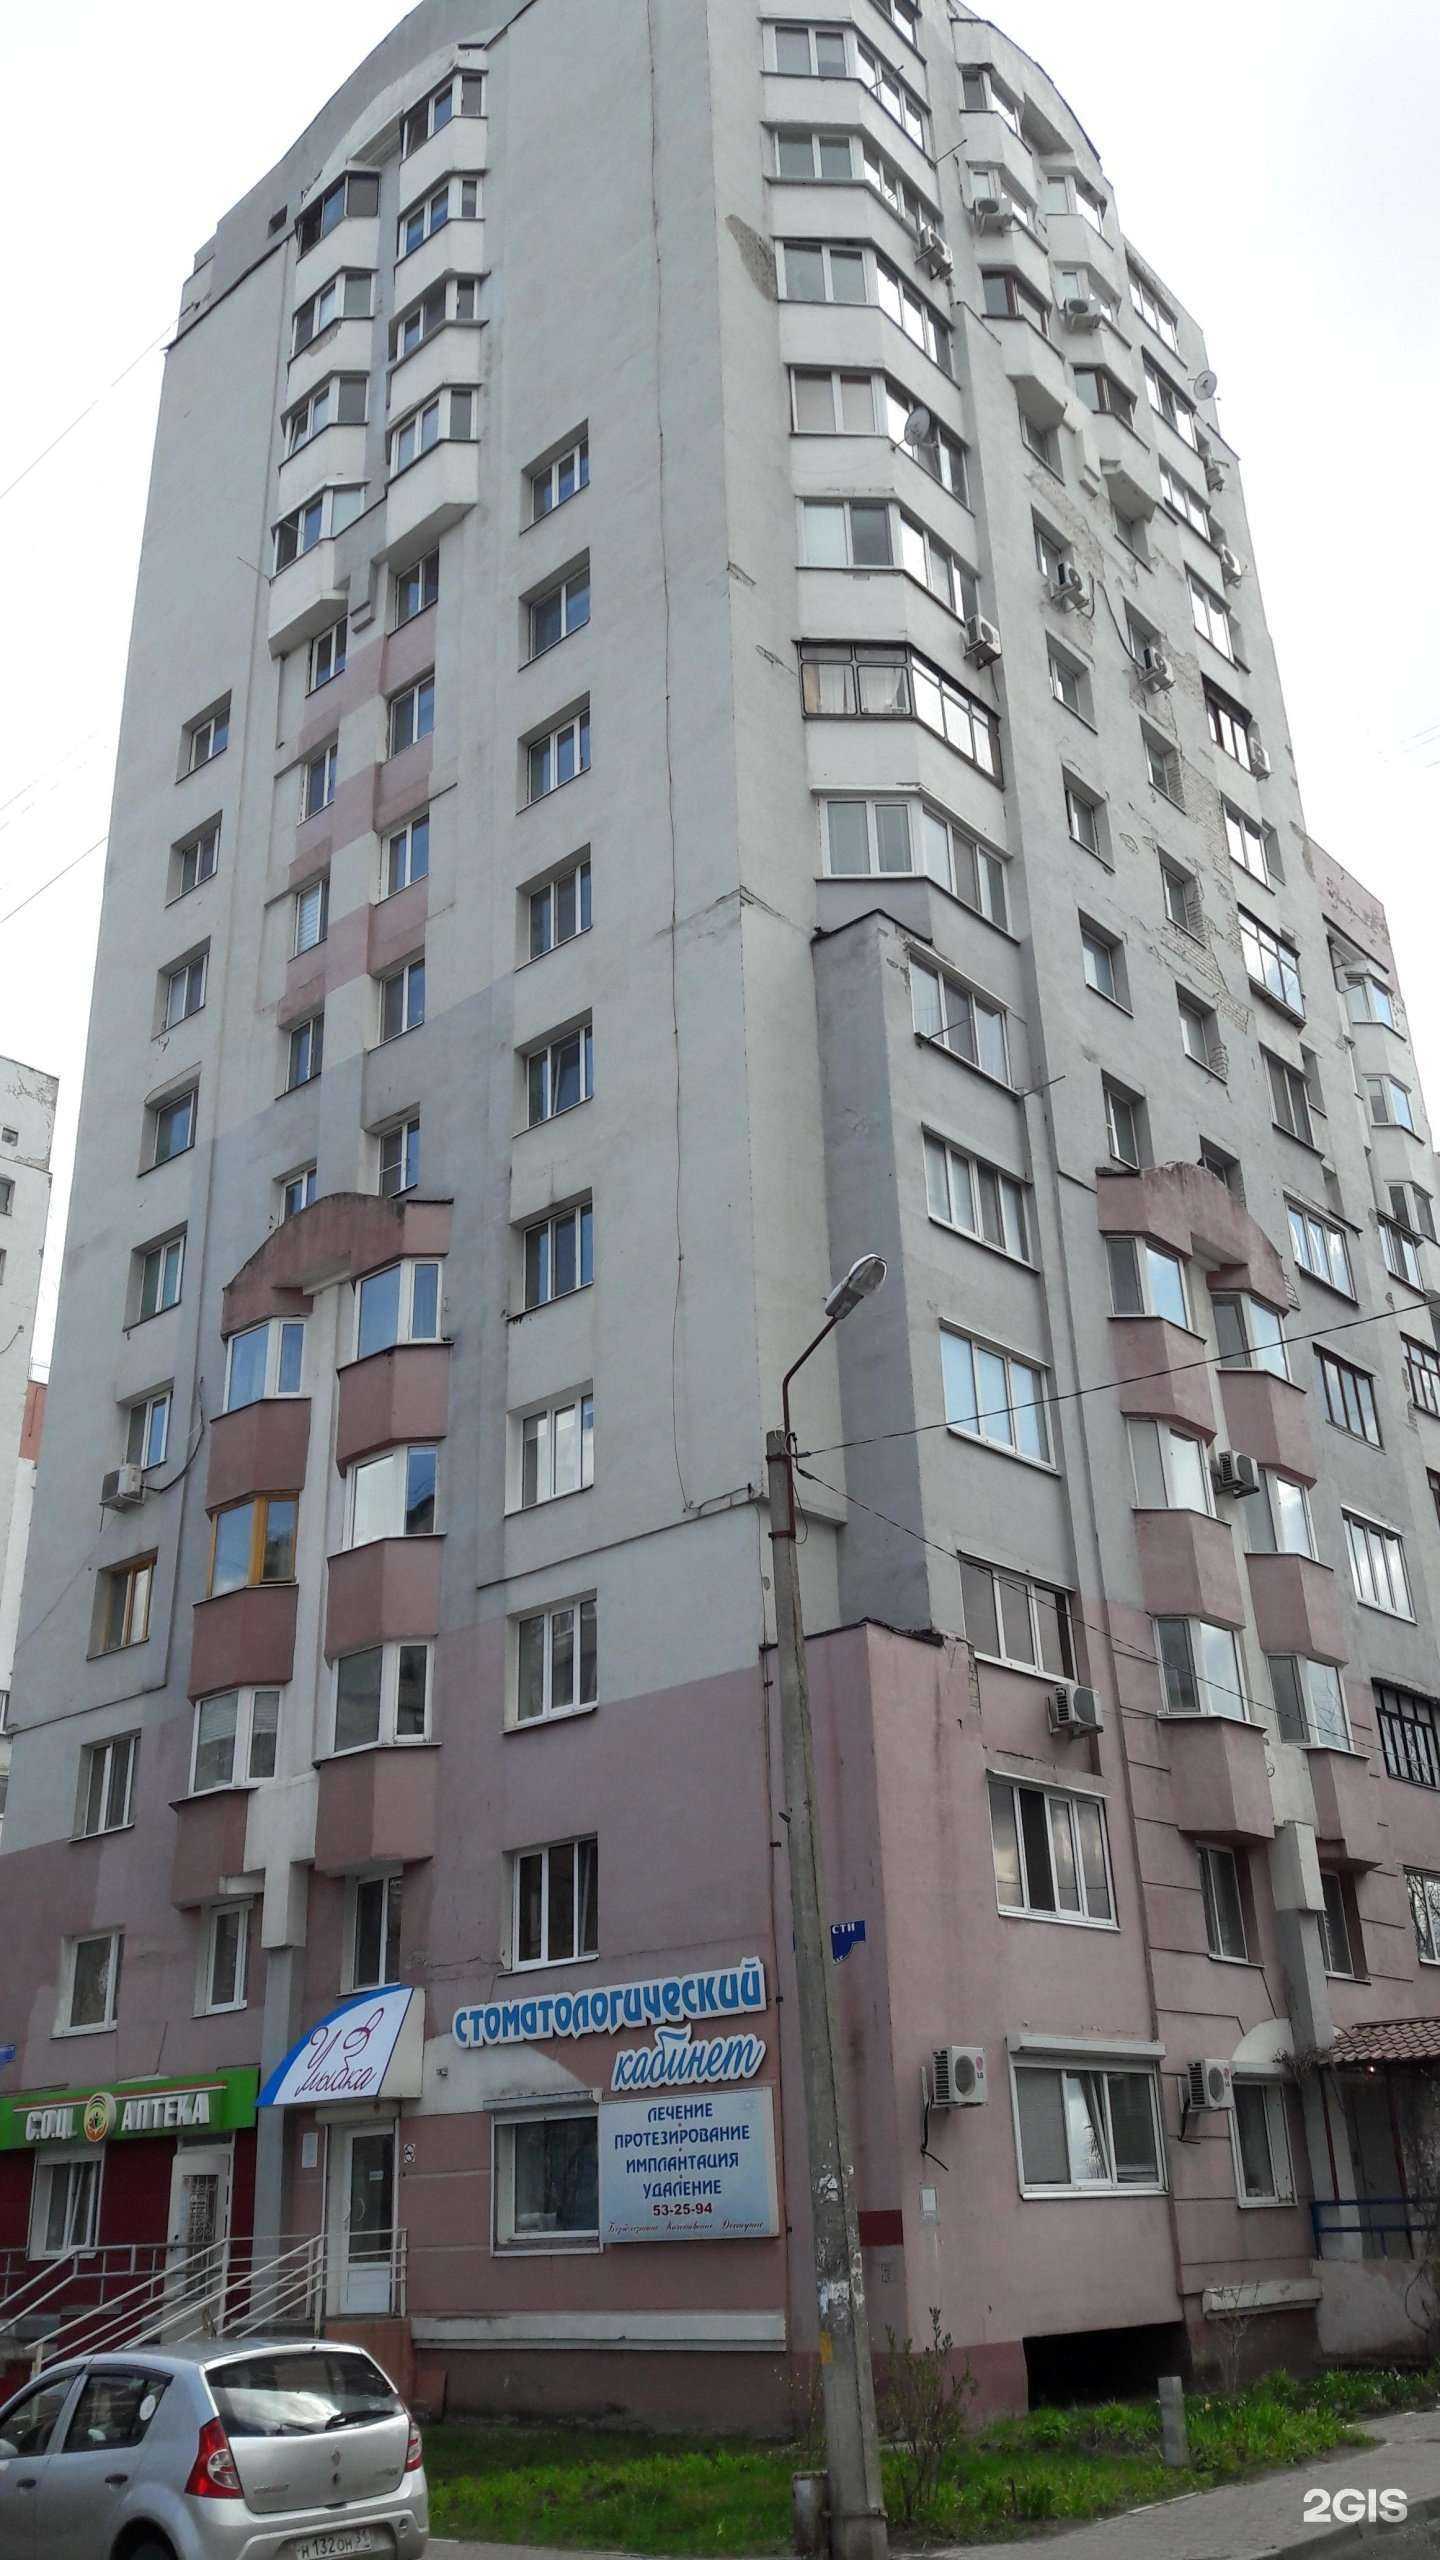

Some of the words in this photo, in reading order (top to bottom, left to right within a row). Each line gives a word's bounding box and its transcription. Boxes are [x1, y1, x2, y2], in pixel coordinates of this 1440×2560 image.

[614, 2029, 764, 2086] кабинет
[121, 2093, 210, 2131] АПТЕКА
[648, 2103, 713, 2123] ЛЕЧЕНИЕ
[614, 2125, 750, 2150] ПРОТЕЗИРОВАНИЕ
[626, 2153, 739, 2173] ИМПЛАНТАЦИЯ
[643, 2180, 722, 2199] УДАЛЕНИЕ
[653, 2203, 713, 2216] 53-25-94
